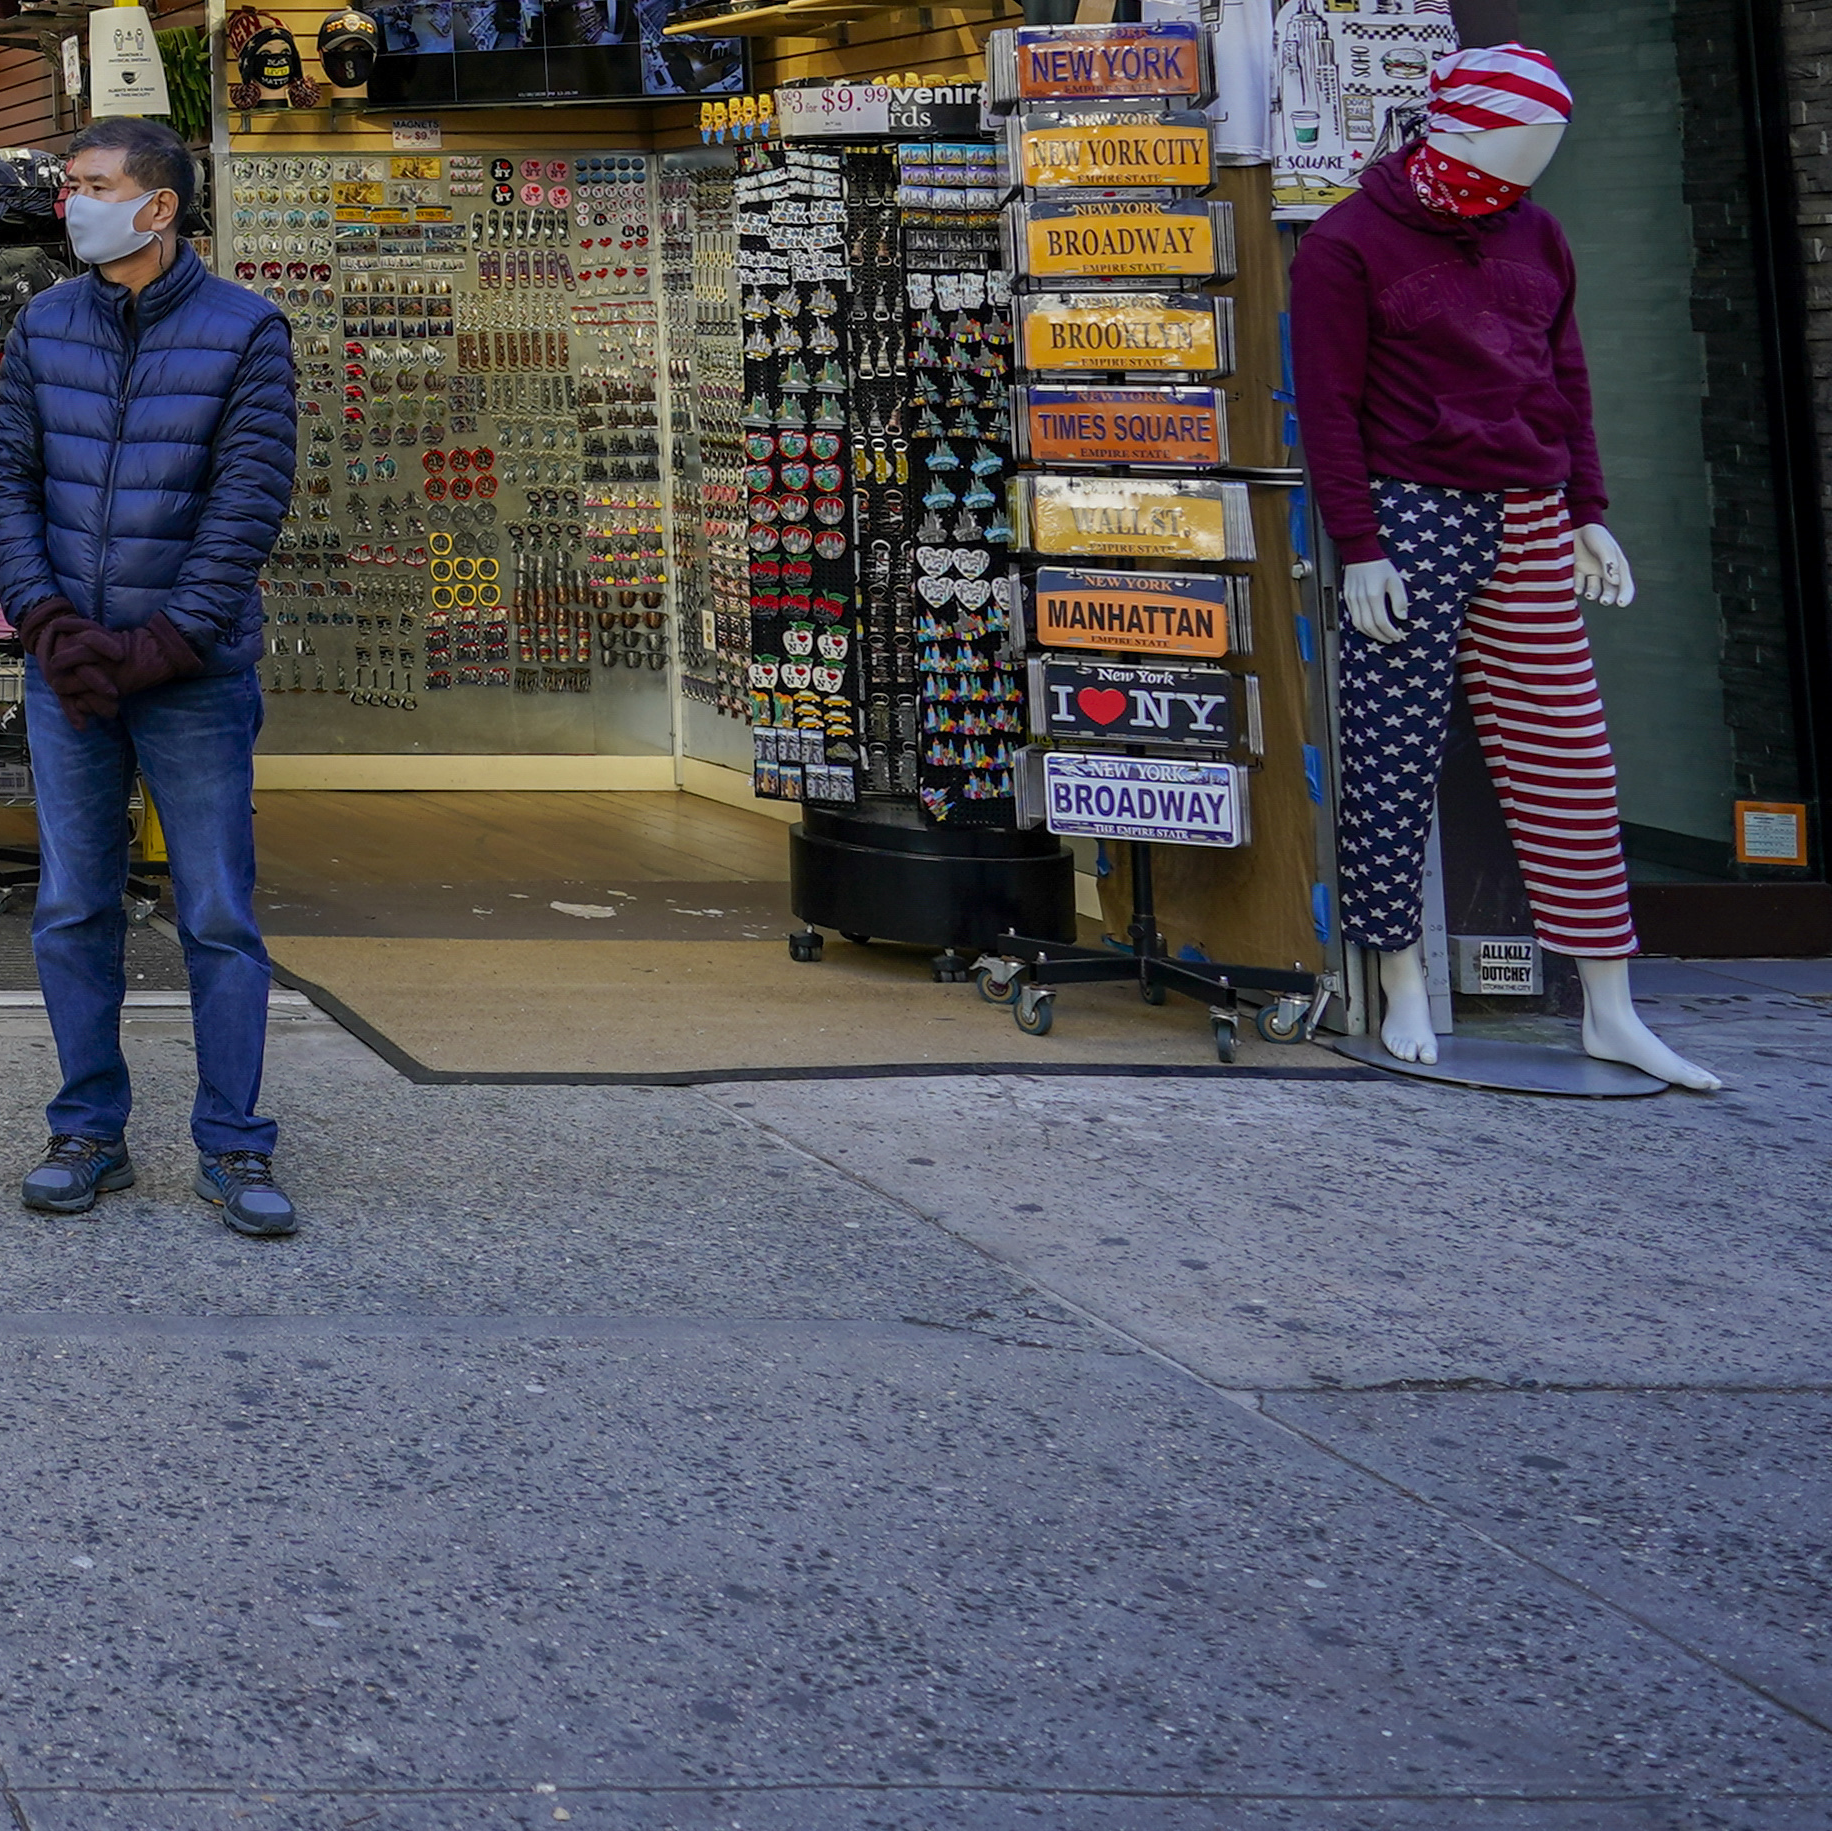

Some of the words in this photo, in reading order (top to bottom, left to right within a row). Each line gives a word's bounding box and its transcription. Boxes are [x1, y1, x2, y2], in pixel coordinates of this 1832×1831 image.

[1032, 49, 1094, 82] NEW
[1100, 47, 1183, 80] YORK
[1064, 85, 1110, 94] EMPIRE
[792, 91, 803, 114] 3
[805, 103, 818, 113] for
[393, 120, 439, 129] MAGNETS
[1113, 113, 1161, 126] YORK
[1031, 140, 1083, 167] NEW
[1087, 138, 1149, 166] YORK
[1152, 138, 1204, 165] CITY
[1078, 175, 1122, 183] EMPIRE
[1125, 174, 1162, 183] STATE
[1075, 204, 1115, 215] NEW
[1116, 203, 1163, 215] YORK
[1047, 227, 1196, 256] BROADWAY
[1082, 264, 1128, 273] EMPIRE
[1129, 263, 1165, 272] STATE
[1050, 321, 1193, 350] BROOKLYN
[1081, 358, 1128, 367] EMPIRE
[1129, 358, 1165, 367] STATE
[1076, 391, 1115, 403] NEW
[1120, 391, 1168, 403] YORK
[1038, 413, 1106, 441] TIMES
[1114, 412, 1212, 443] SQUARE
[1080, 448, 1129, 458] EMPIRE
[1132, 449, 1171, 459] STATE
[1070, 507, 1146, 536] WALL
[1150, 506, 1191, 538] ST.
[1084, 575, 1124, 589] NEW
[1125, 577, 1173, 592] YORK
[1047, 599, 1214, 639] MANHATTAN
[1091, 635, 1133, 646] EMPIRE
[1134, 637, 1170, 648] STATE
[1098, 668, 1135, 683] New
[1136, 670, 1175, 686] York
[1050, 684, 1076, 722] I
[1090, 761, 1130, 780] NEW
[1136, 763, 1185, 782] YORK
[1054, 782, 1225, 825] BROADWAY
[1093, 823, 1114, 834] THE
[1116, 825, 1153, 837] EMPIRE
[1156, 829, 1188, 840] STATE
[1482, 944, 1532, 960] ALLKILZ
